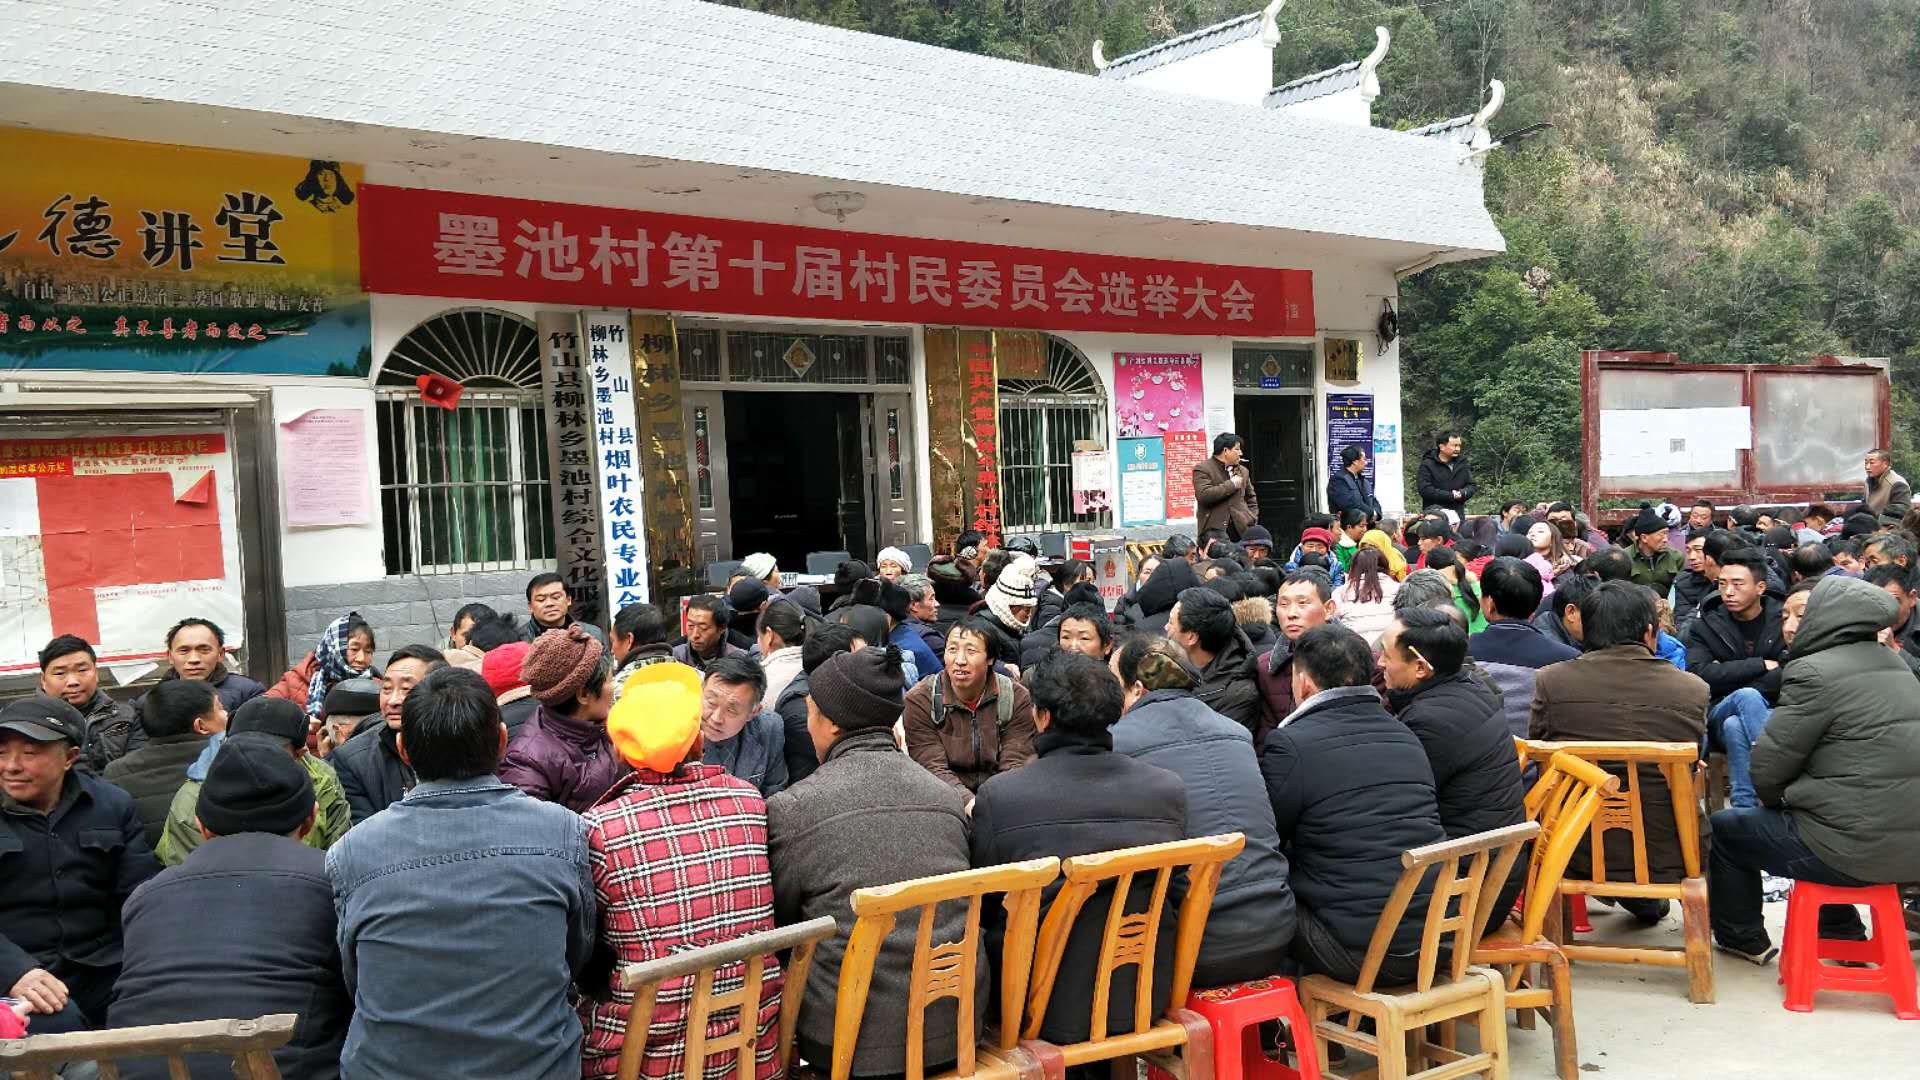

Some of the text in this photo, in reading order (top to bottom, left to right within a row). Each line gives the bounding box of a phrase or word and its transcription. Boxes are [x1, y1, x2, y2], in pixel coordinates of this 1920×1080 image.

[0, 192, 286, 270] 德讲堂
[433, 212, 1256, 323] 墨池村第十届村民委员会选举大会
